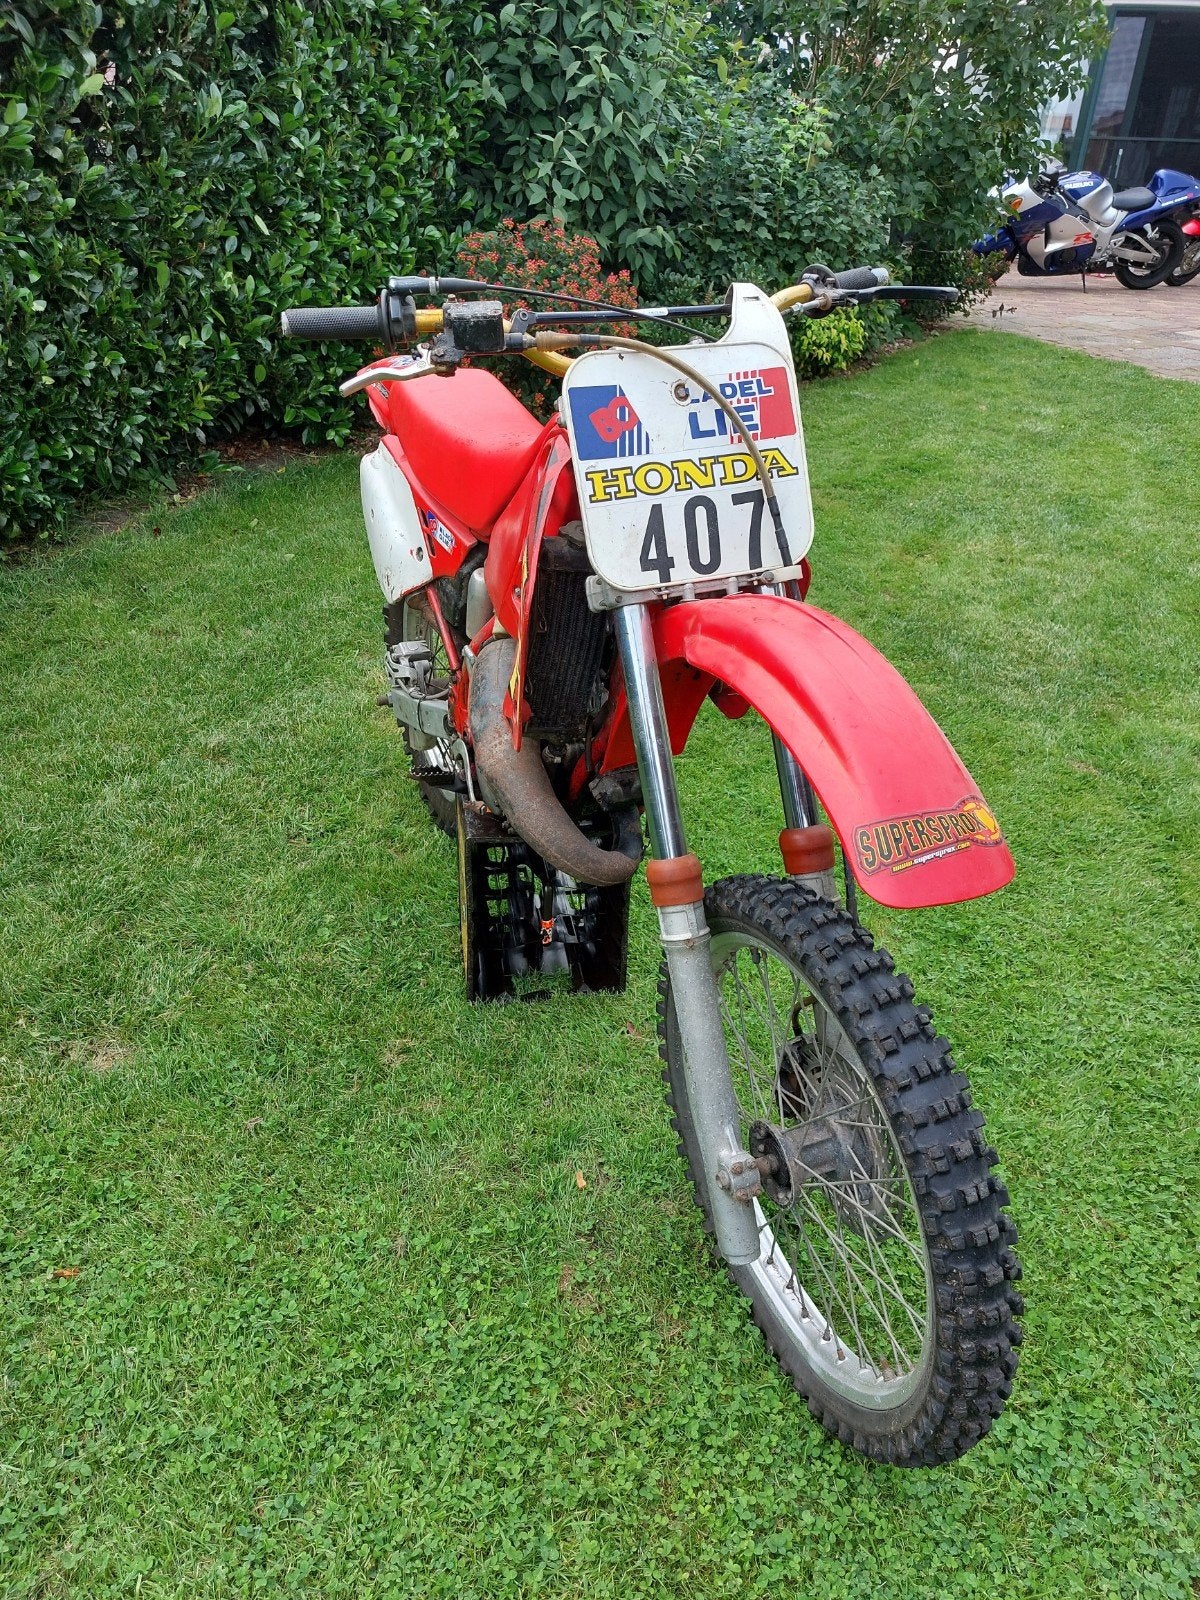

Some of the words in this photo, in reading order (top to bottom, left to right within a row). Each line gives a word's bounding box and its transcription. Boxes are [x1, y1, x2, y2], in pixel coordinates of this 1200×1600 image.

[585, 447, 799, 503] HONDA
[640, 489, 765, 583] 407
[858, 811, 986, 869] SUPERSPROX
